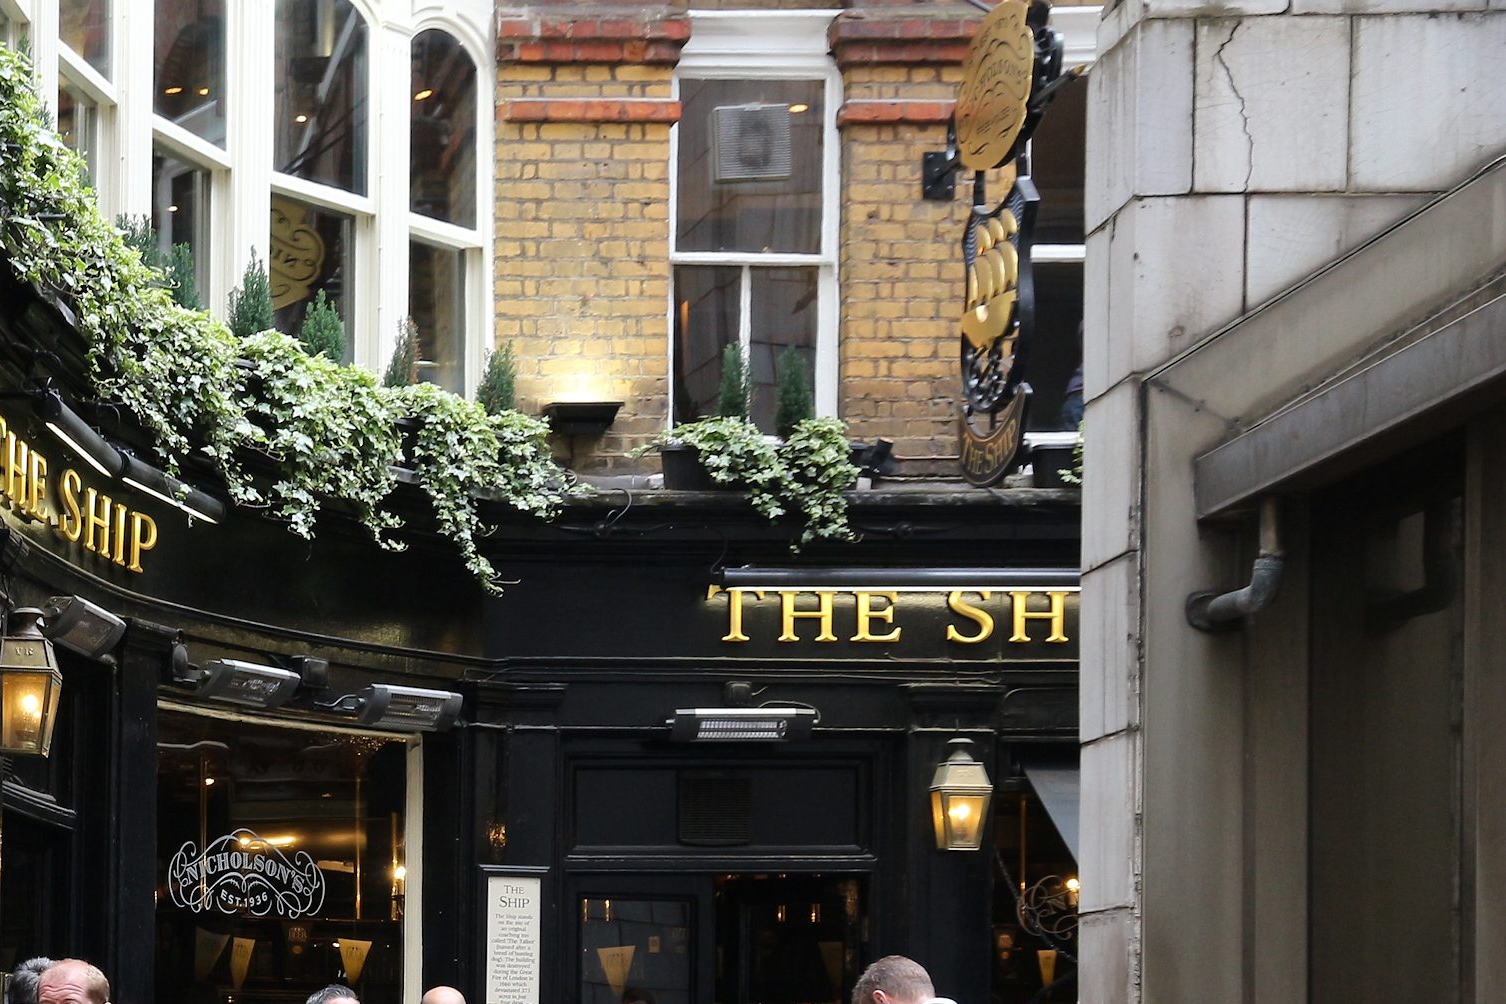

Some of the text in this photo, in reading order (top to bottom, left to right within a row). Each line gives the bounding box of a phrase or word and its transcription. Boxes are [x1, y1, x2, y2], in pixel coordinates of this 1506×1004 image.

[961, 419, 1017, 475] THE SHIP
[59, 468, 158, 574] SHIP
[705, 584, 1070, 643] THE SH
[185, 851, 305, 894] NICHOLSON'S
[504, 885, 524, 894] THE
[500, 896, 529, 908] SHIP
